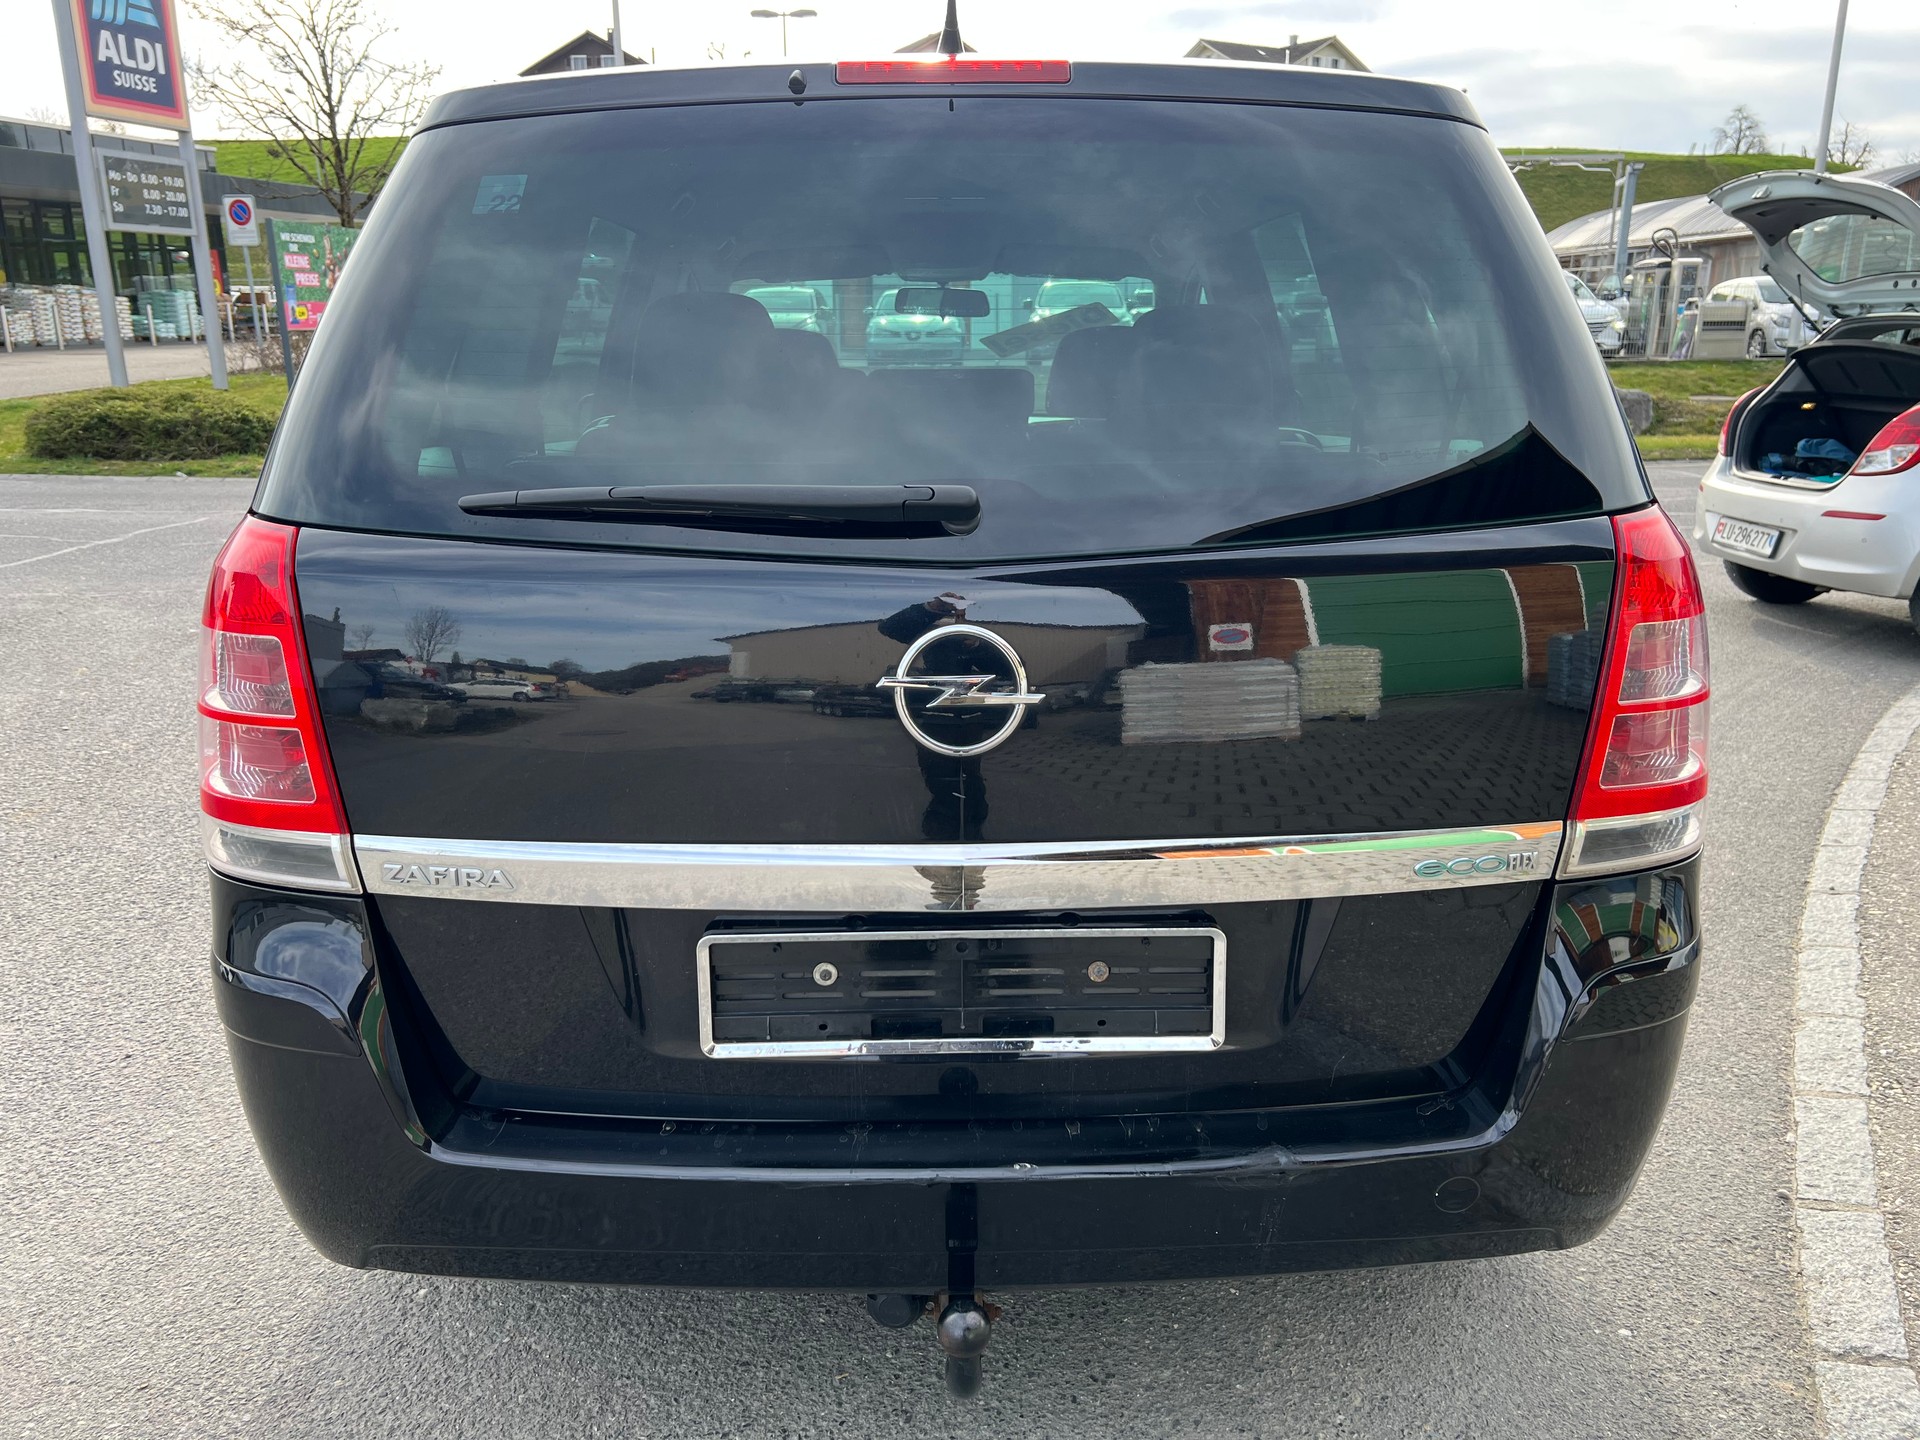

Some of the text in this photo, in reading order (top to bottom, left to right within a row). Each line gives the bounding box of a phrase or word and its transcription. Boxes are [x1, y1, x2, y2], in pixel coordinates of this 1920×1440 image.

[99, 29, 166, 75] ALDI
[113, 69, 158, 93] SUISSE
[110, 185, 119, 197] Fr
[113, 201, 124, 213] Sa
[383, 864, 515, 889] ZAFIRA
